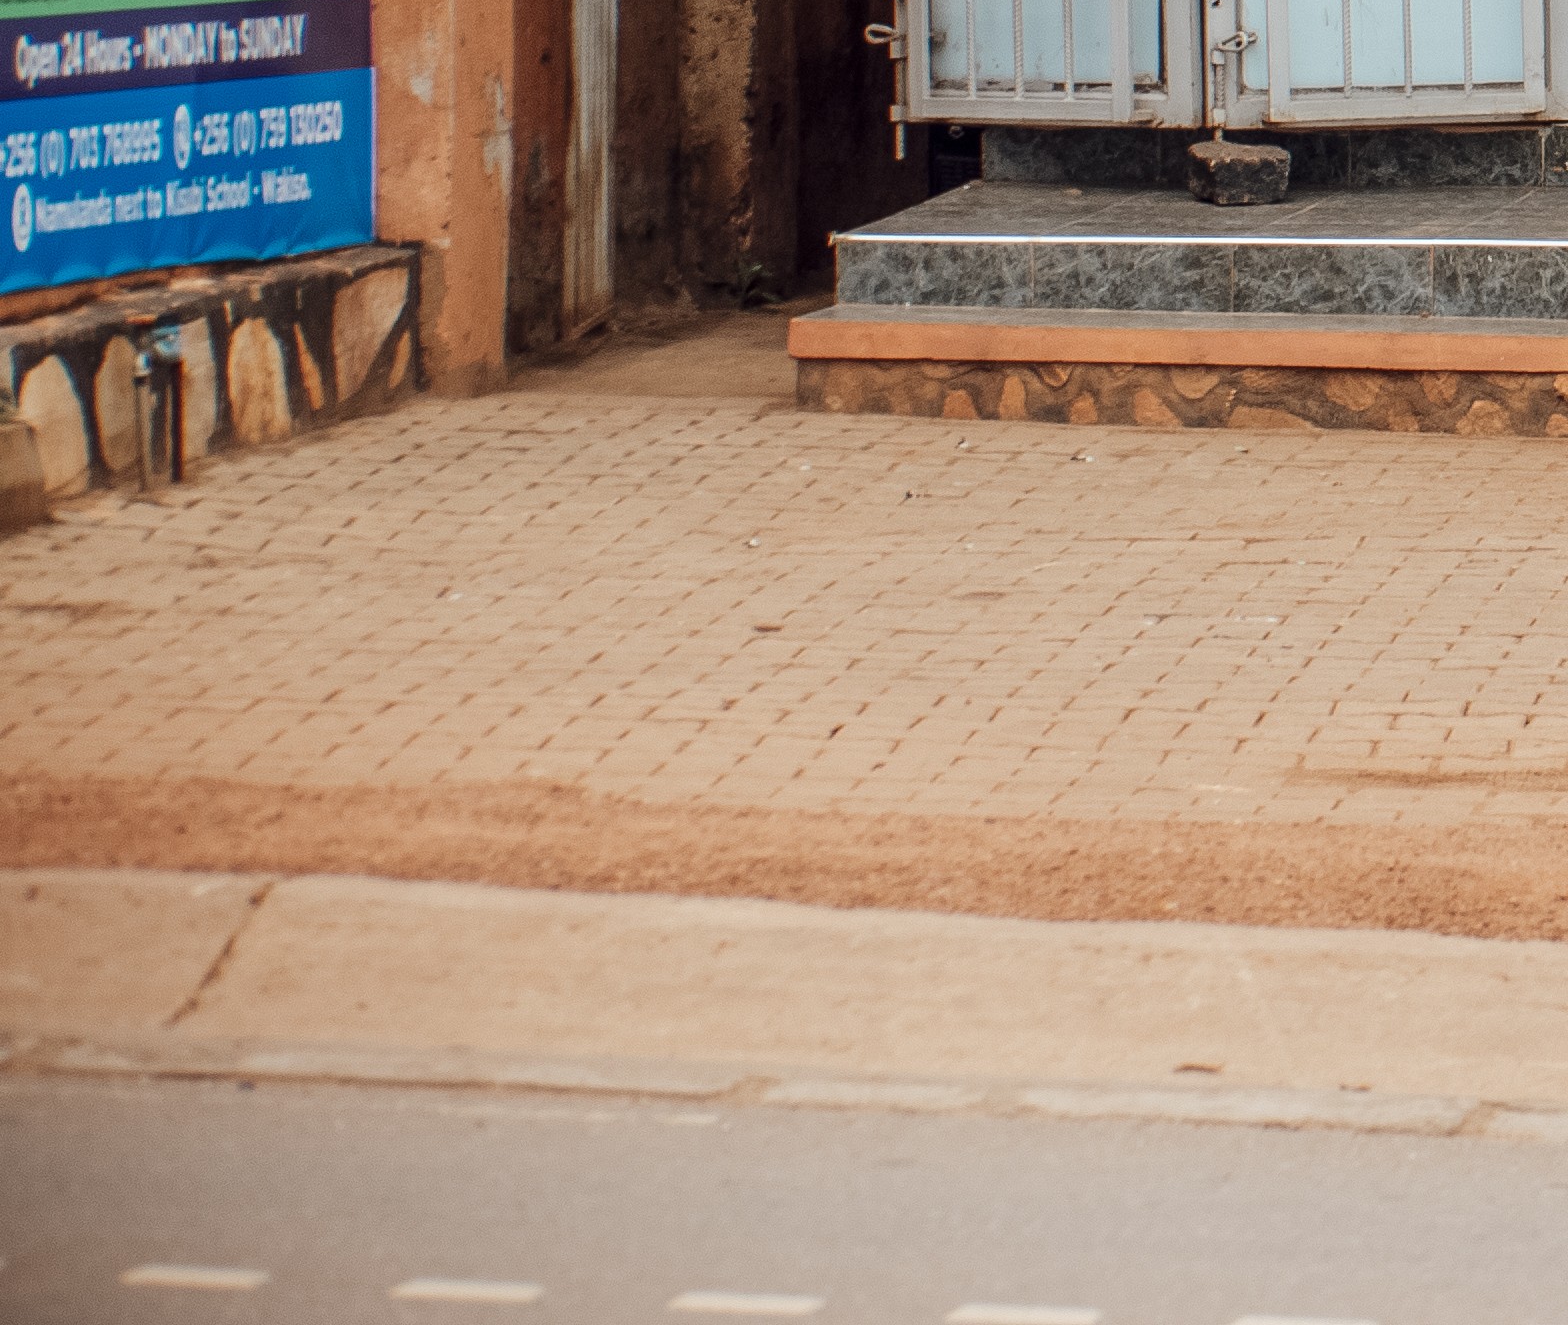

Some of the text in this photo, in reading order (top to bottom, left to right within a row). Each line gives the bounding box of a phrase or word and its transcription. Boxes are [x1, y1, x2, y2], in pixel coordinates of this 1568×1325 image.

[14, 33, 61, 90] Open
[61, 30, 84, 78] 24
[84, 30, 135, 74] Hours
[143, 21, 219, 70] MONDAY
[239, 13, 308, 61] SUNDAY
